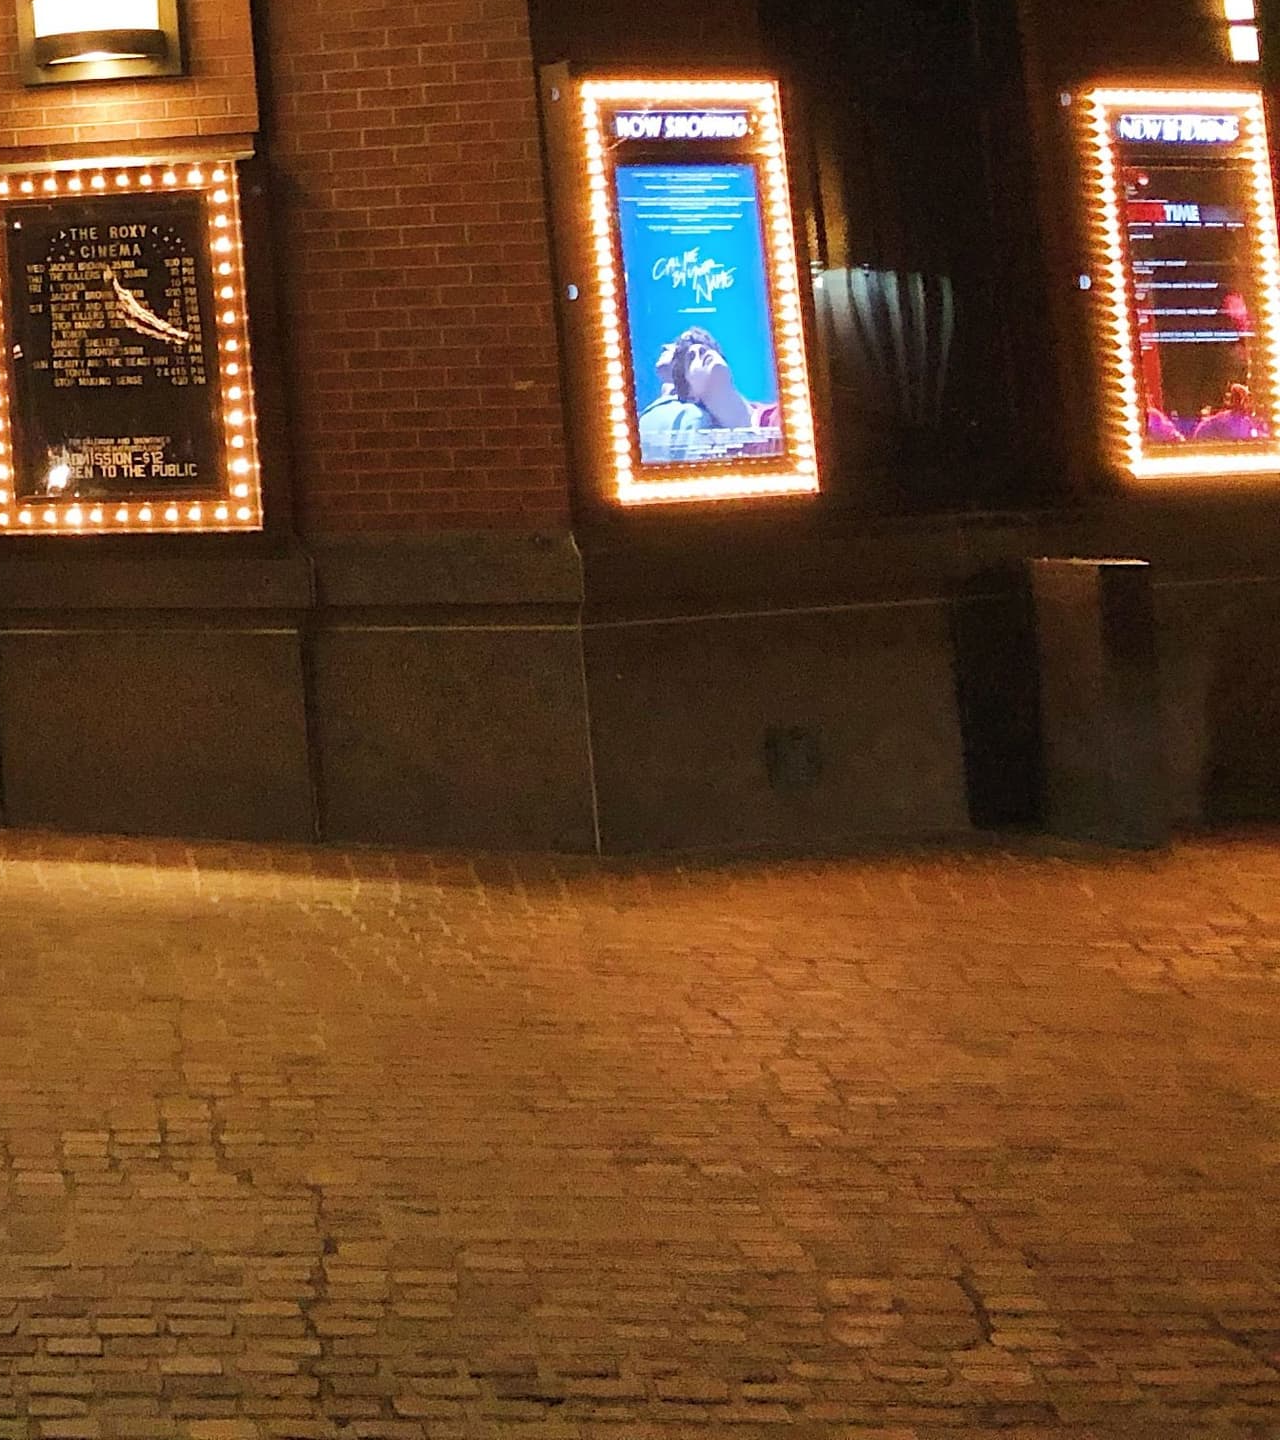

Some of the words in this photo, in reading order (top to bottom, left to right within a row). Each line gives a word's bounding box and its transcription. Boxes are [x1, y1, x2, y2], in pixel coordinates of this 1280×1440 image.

[616, 115, 662, 137] NOW
[69, 227, 98, 240] THE
[109, 225, 147, 238] ROXY
[80, 244, 141, 258] CINEMA
[101, 465, 116, 478] TO
[120, 464, 146, 477] THE
[151, 463, 198, 477] PUBLIC
